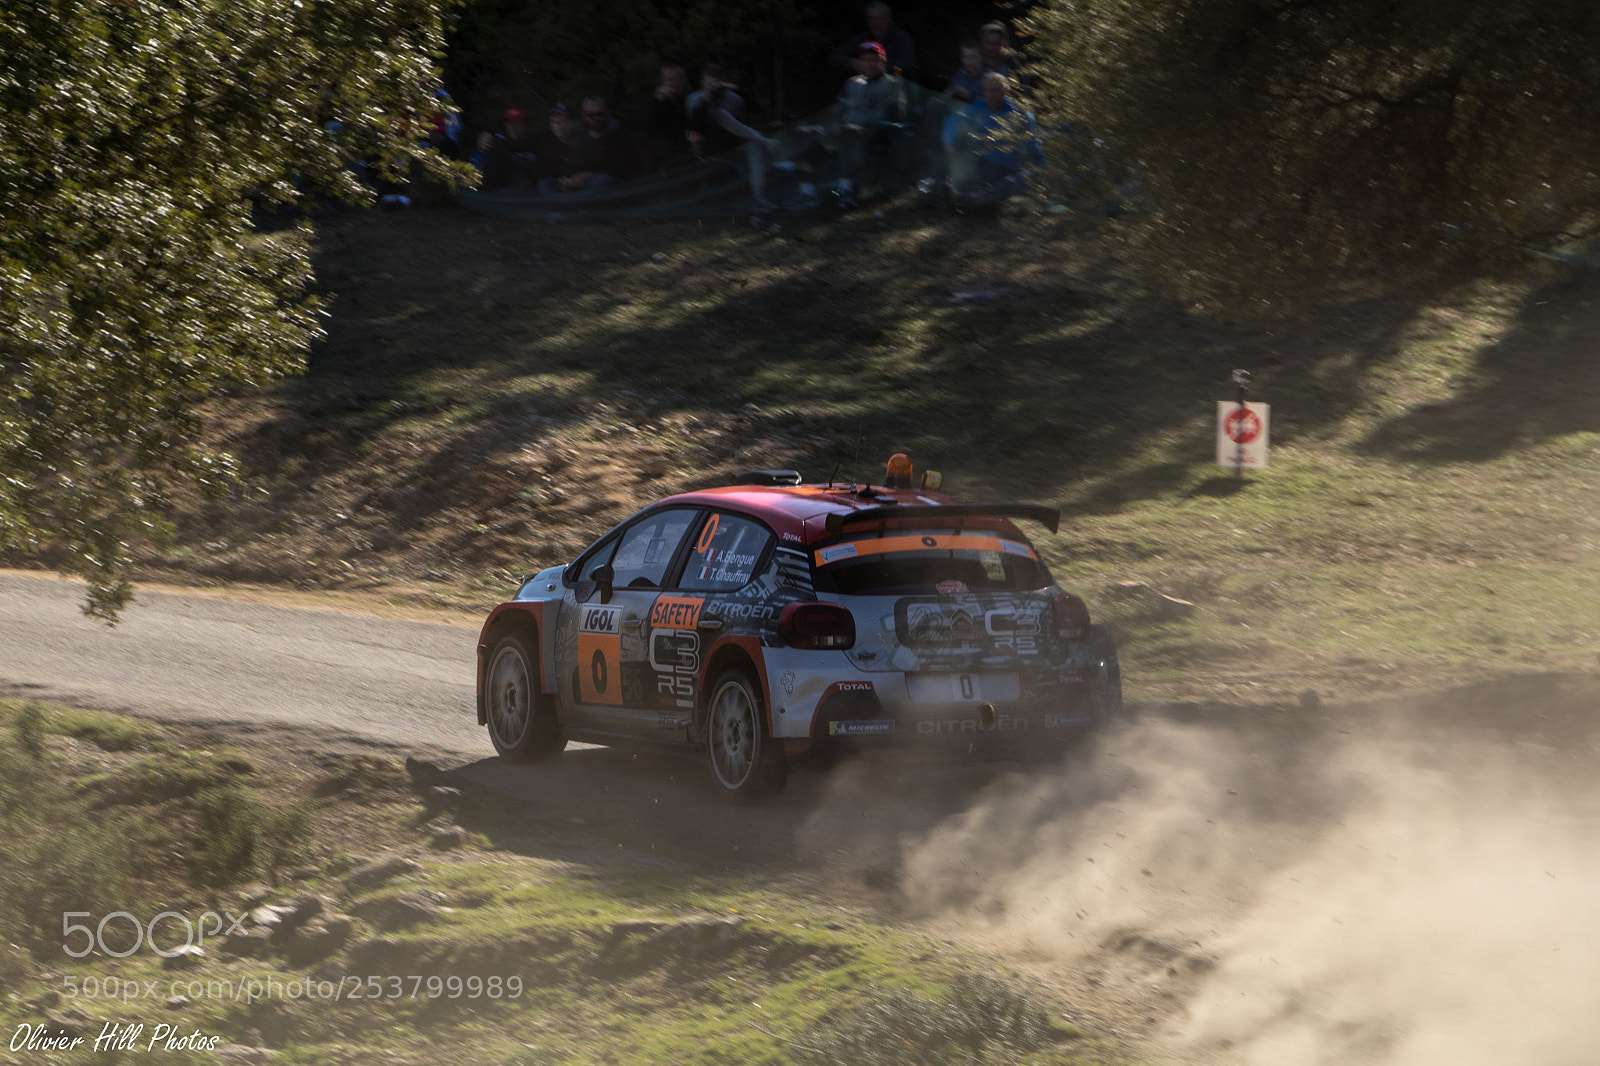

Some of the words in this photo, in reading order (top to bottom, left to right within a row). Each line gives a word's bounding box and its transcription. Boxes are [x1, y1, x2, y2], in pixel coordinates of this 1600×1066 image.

[698, 514, 719, 553] 0
[783, 532, 802, 542] TOTAL
[584, 608, 615, 632] IGOL
[652, 601, 700, 626] SAFETY
[649, 627, 700, 675] C3
[591, 648, 608, 695] 0
[836, 682, 872, 692] TOTAL
[848, 723, 890, 733] MICHELIN
